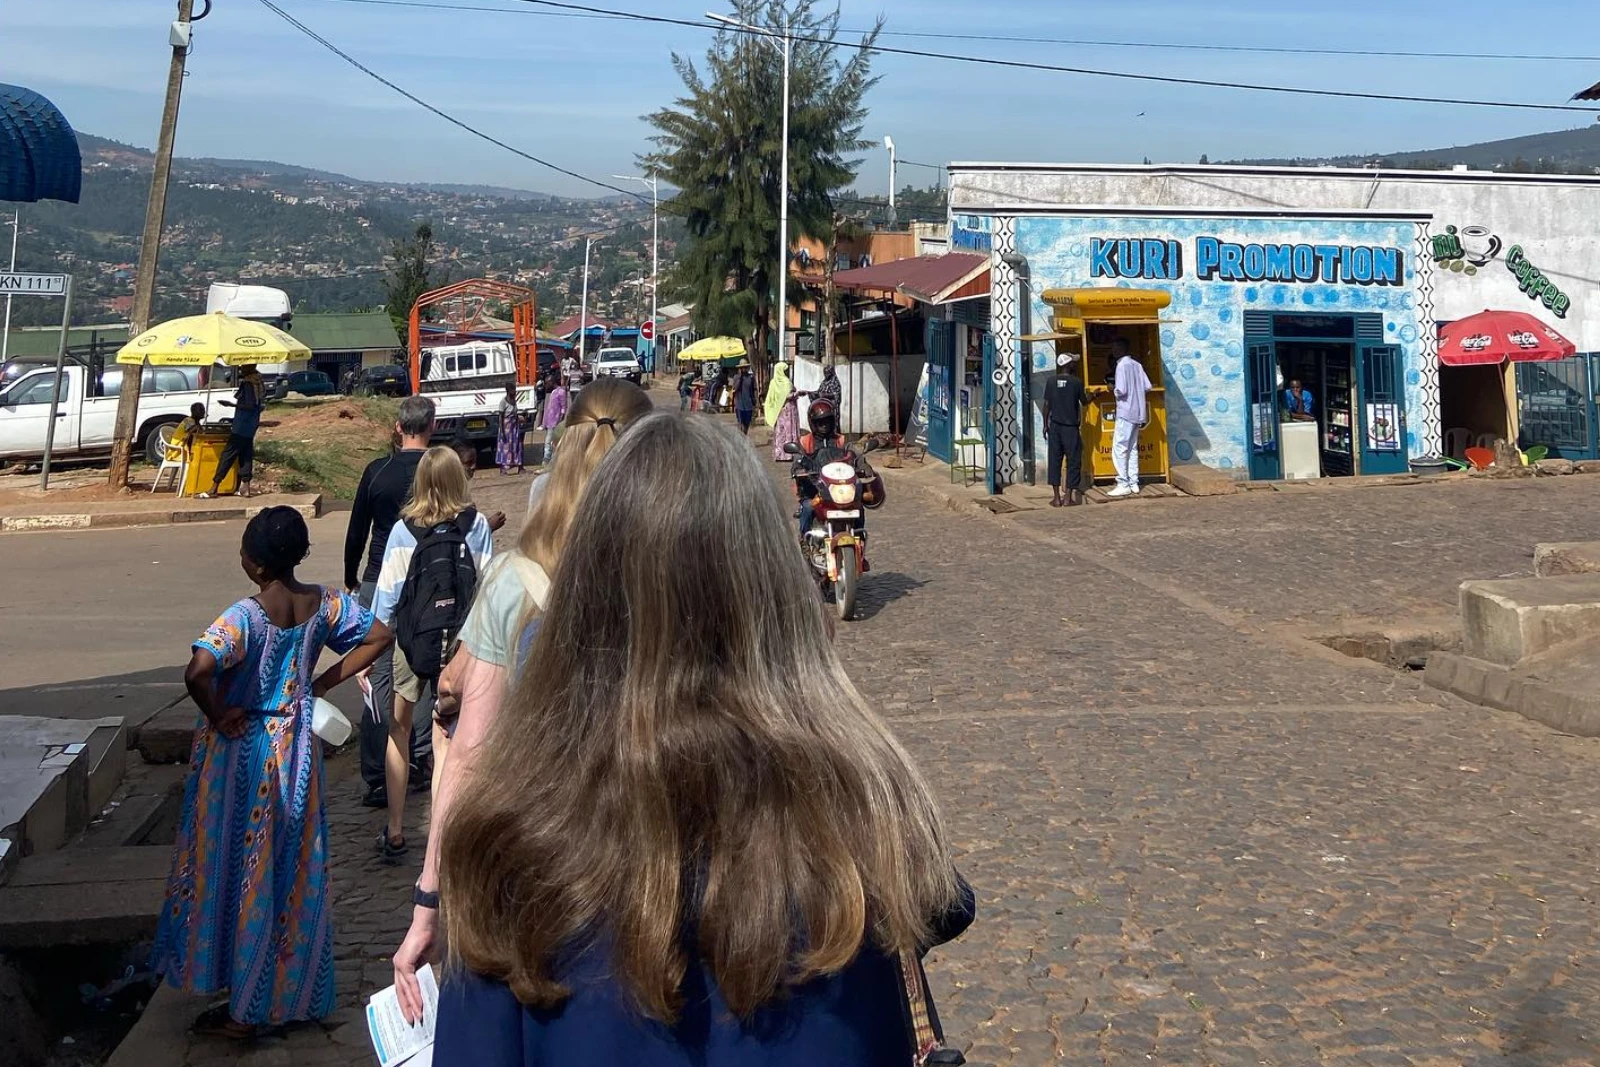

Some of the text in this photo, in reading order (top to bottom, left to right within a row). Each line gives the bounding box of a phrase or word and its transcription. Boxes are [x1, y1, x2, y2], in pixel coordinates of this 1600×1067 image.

[0, 276, 21, 289] KN
[27, 277, 51, 289] 111
[1090, 236, 1403, 286] KURI PROMOTION
[1505, 245, 1570, 319] Coffee
